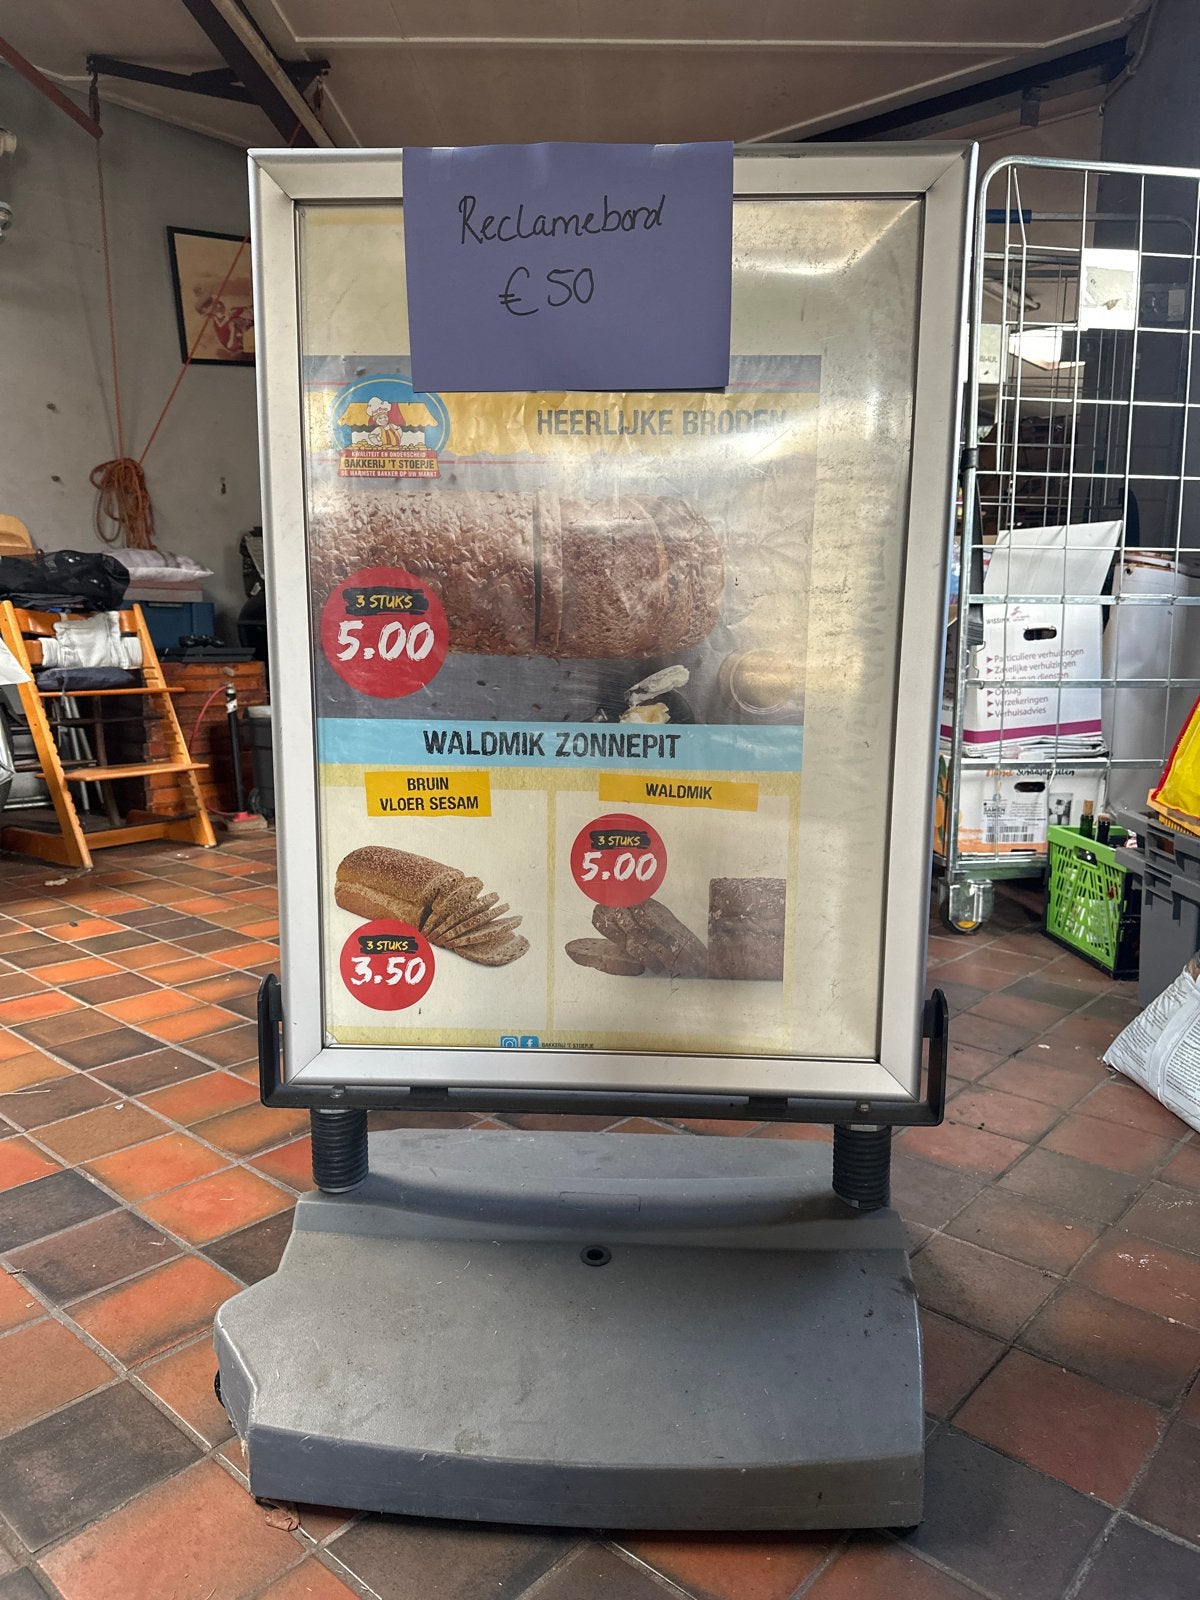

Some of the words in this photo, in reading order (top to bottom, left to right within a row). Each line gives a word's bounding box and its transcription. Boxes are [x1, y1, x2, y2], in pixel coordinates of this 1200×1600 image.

[458, 194, 666, 244] Reclamebord
[546, 268, 594, 306] 50
[537, 409, 673, 436] HEERLIJKE
[344, 459, 386, 469] BAKKERIJ
[398, 460, 435, 469] STOEPJE
[355, 595, 365, 607] 3
[369, 594, 413, 609] STUKS
[336, 620, 435, 661] 5.00
[422, 730, 546, 757] WALDMIK
[555, 731, 682, 759] ZONNEPIT
[407, 776, 449, 791] BRUIN
[645, 783, 713, 800] WALDMIK
[380, 796, 425, 812] VLOER
[429, 795, 479, 811] SESAM
[597, 835, 605, 846] 3
[608, 835, 641, 847] STUKS
[581, 851, 658, 882] 5.00
[366, 940, 374, 950] 3
[377, 940, 409, 951] STUKS
[350, 956, 427, 985] 3.50
